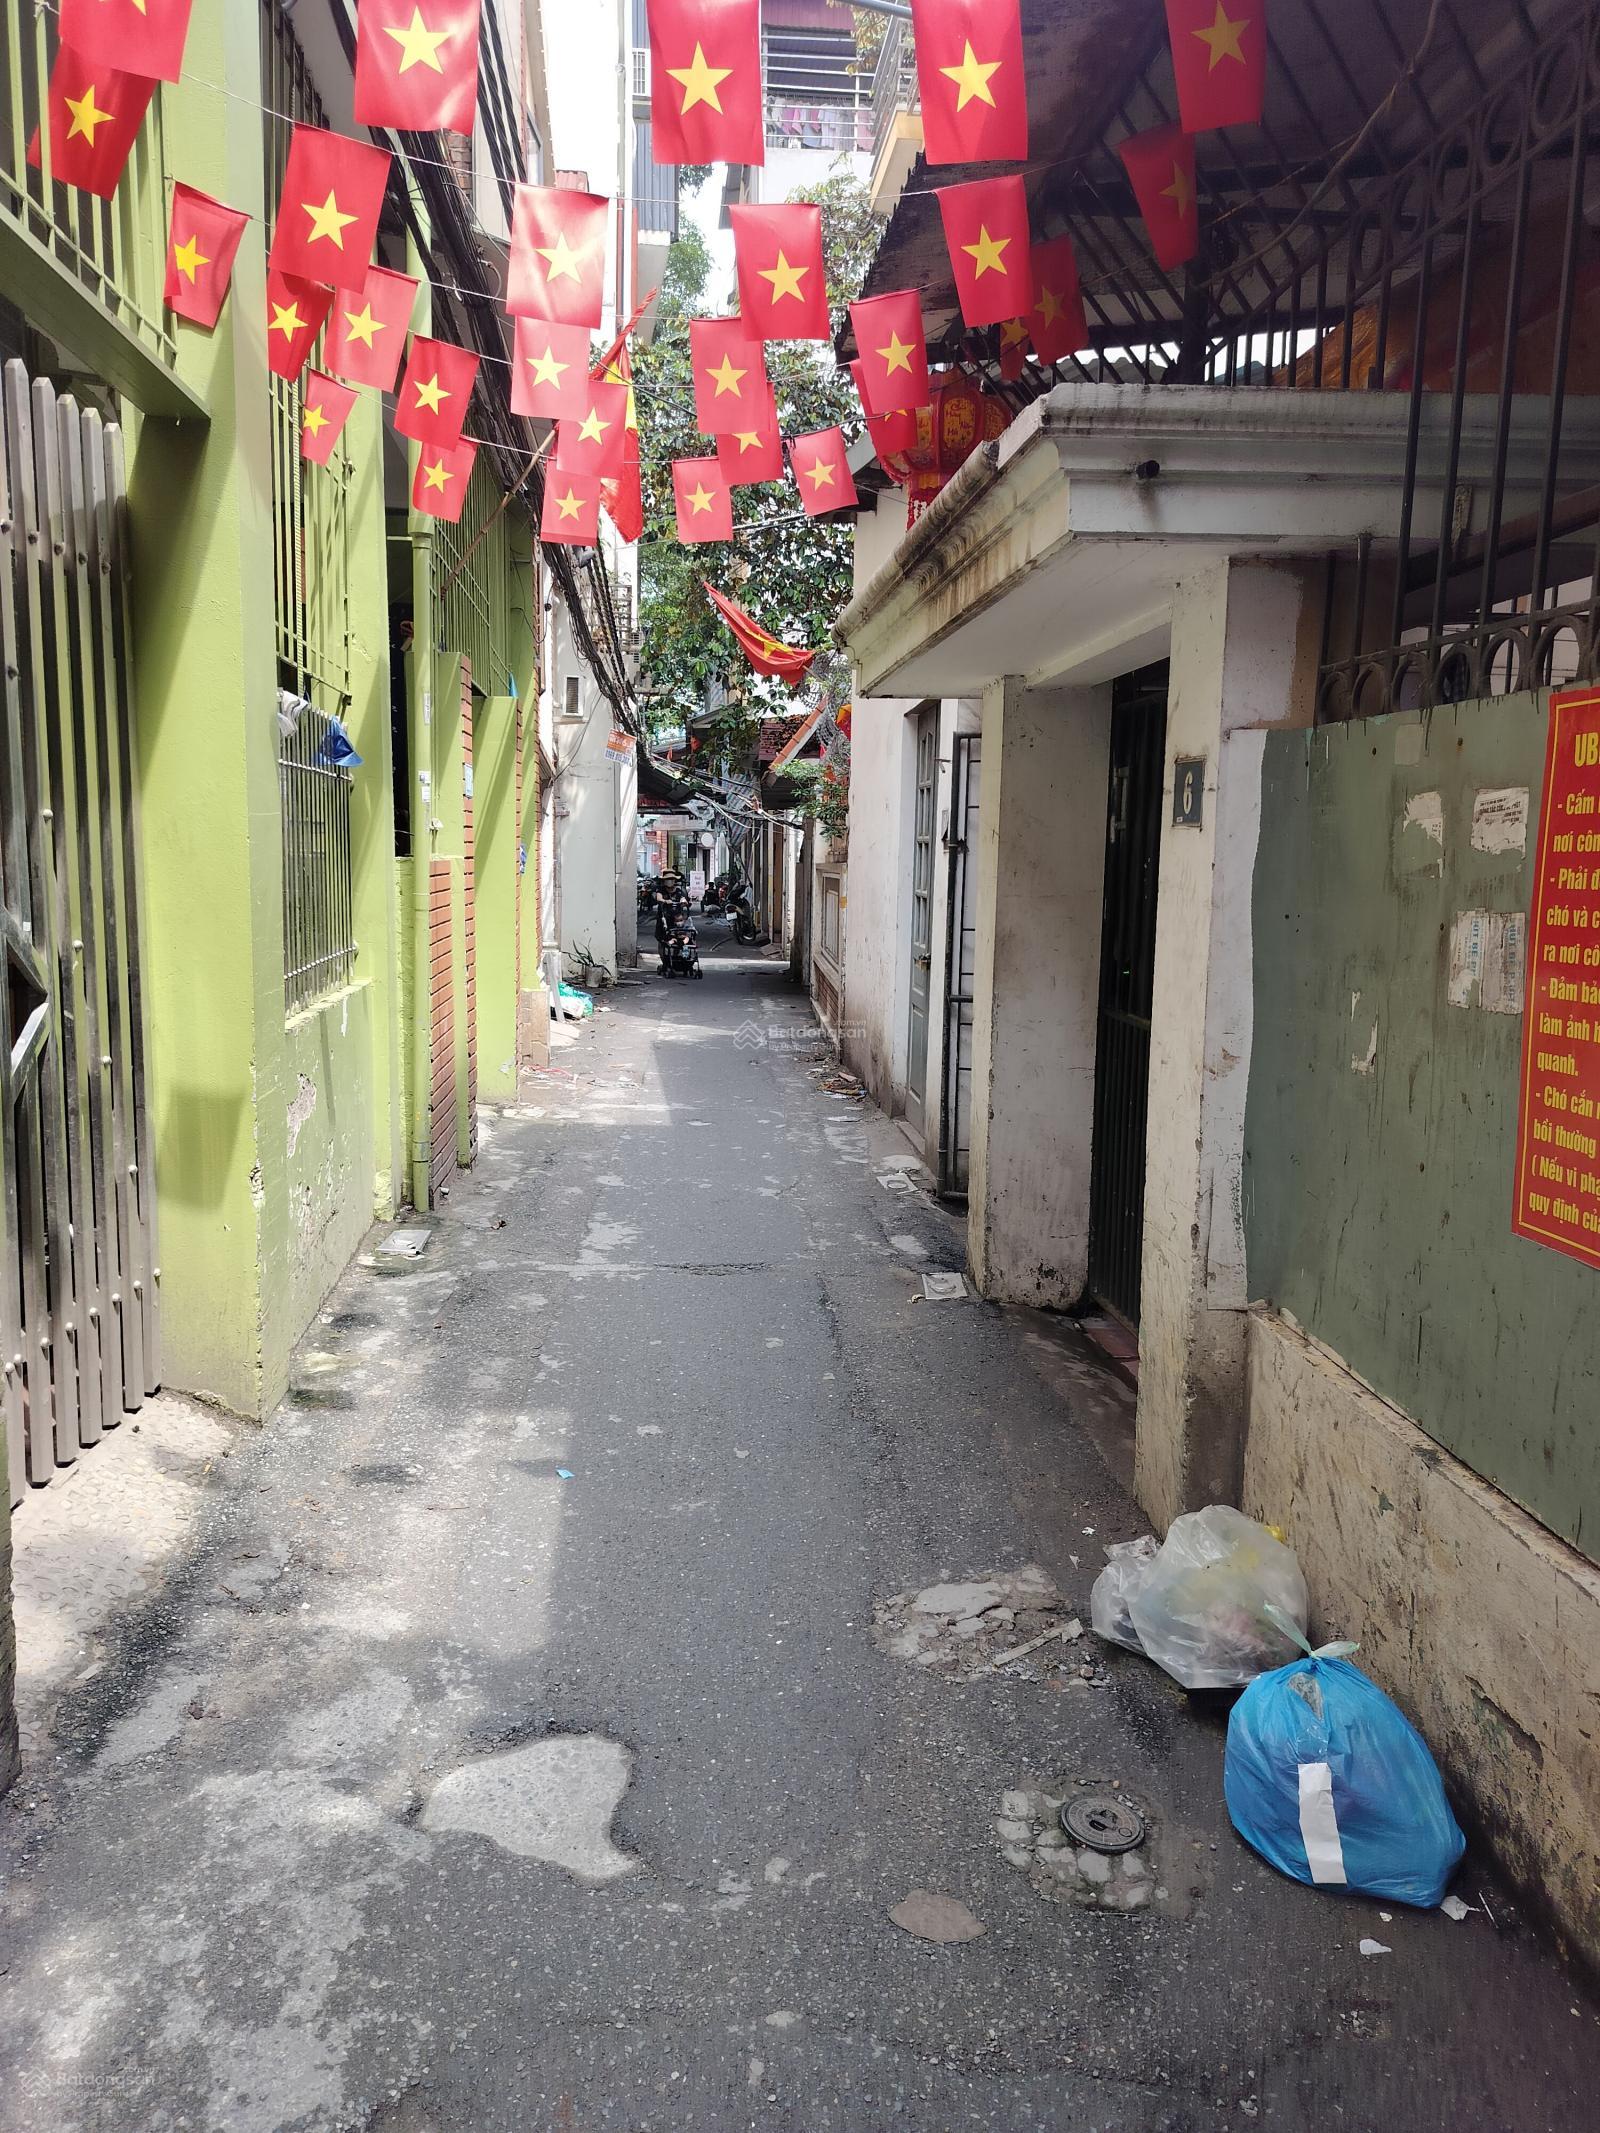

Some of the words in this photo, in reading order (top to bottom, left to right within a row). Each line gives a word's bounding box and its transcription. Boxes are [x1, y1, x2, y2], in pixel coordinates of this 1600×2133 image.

[1574, 732, 1600, 767] UB
[1183, 770, 1193, 815] 6
[1566, 788, 1595, 816] Cấm
[1553, 829, 1573, 853] nơi
[1558, 865, 1587, 890] Phải
[1546, 904, 1569, 927] chó
[1573, 905, 1588, 928] và
[1543, 944, 1556, 962] ra
[1559, 943, 1580, 965] nơi
[1549, 976, 1577, 1002] Đảm
[1581, 979, 1600, 1005] bả
[1539, 1012, 1562, 1037] làm
[1566, 1014, 1590, 1041] ảnh
[1537, 1051, 1579, 1077] quanh.
[1543, 1085, 1568, 1111] Chó
[1570, 1089, 1594, 1120] cắn
[1532, 1118, 1553, 1143] bồi
[1555, 1124, 1597, 1160] thường
[1540, 1156, 1564, 1183] Nếu
[1566, 1167, 1577, 1188] vi
[1529, 1191, 1551, 1216] quy
[1552, 1197, 1580, 1225] định
